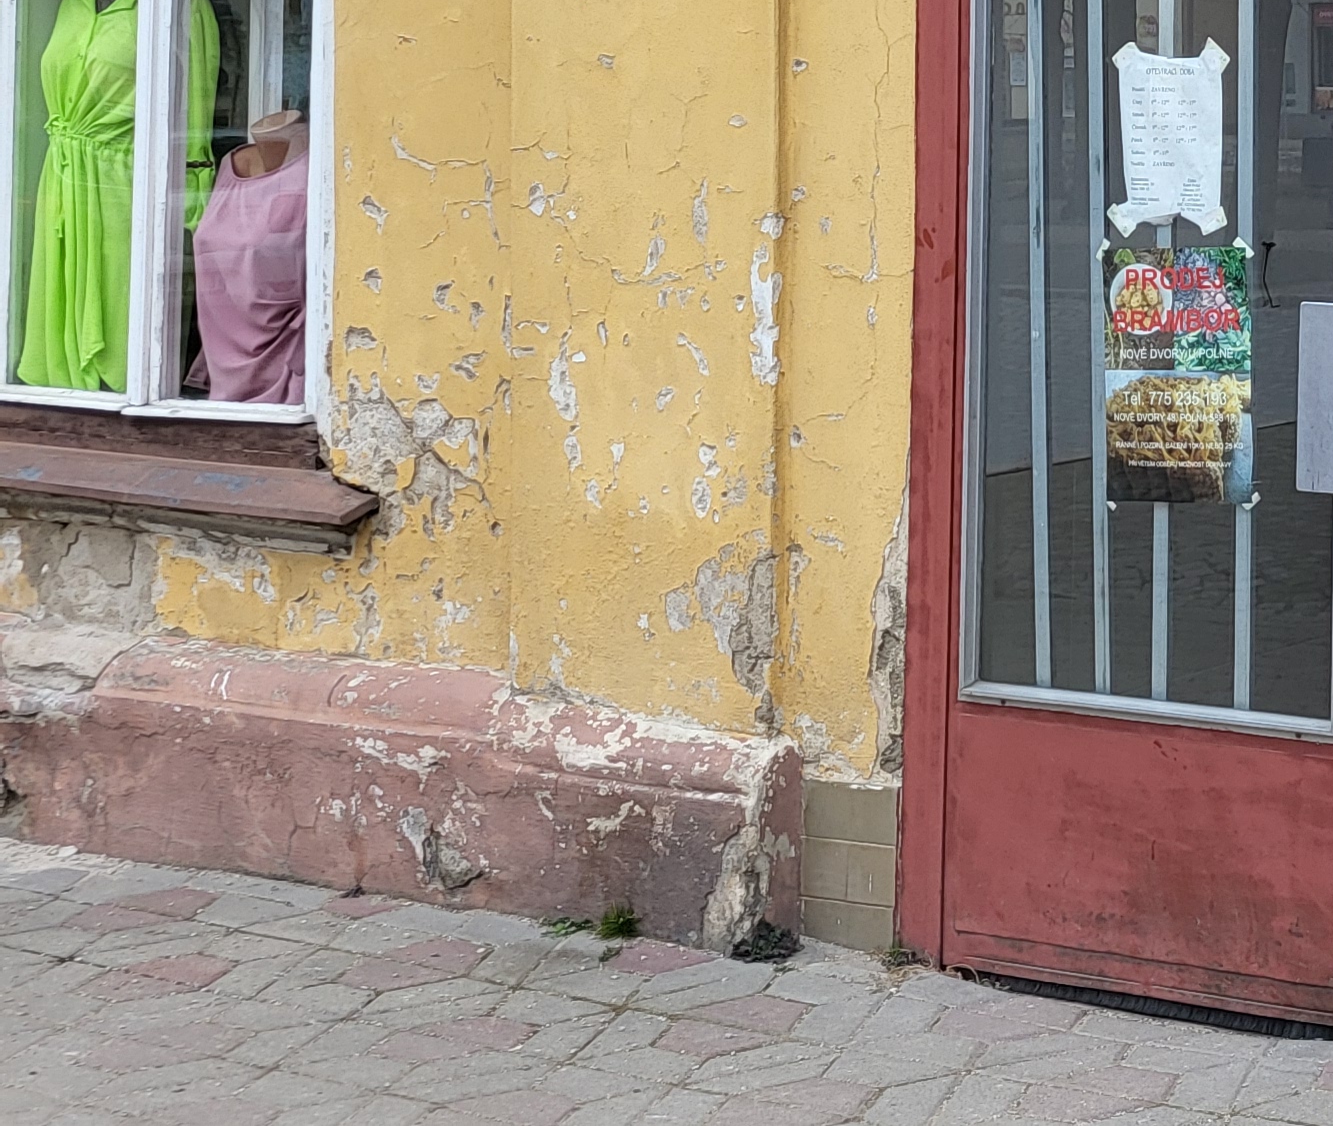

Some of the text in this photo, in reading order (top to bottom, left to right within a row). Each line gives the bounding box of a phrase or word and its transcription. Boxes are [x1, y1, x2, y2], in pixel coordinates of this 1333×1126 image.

[1124, 266, 1225, 291] PRODEJ
[1112, 307, 1241, 333] BRAMBOR
[1120, 346, 1148, 360] NOVÉ
[1149, 348, 1186, 360] DVORY
[1123, 390, 1145, 406] Tel.
[1148, 391, 1172, 406] 775
[1175, 391, 1200, 406] 235
[1113, 412, 1136, 423] NOVÉ
[1136, 412, 1165, 423] DVORY
